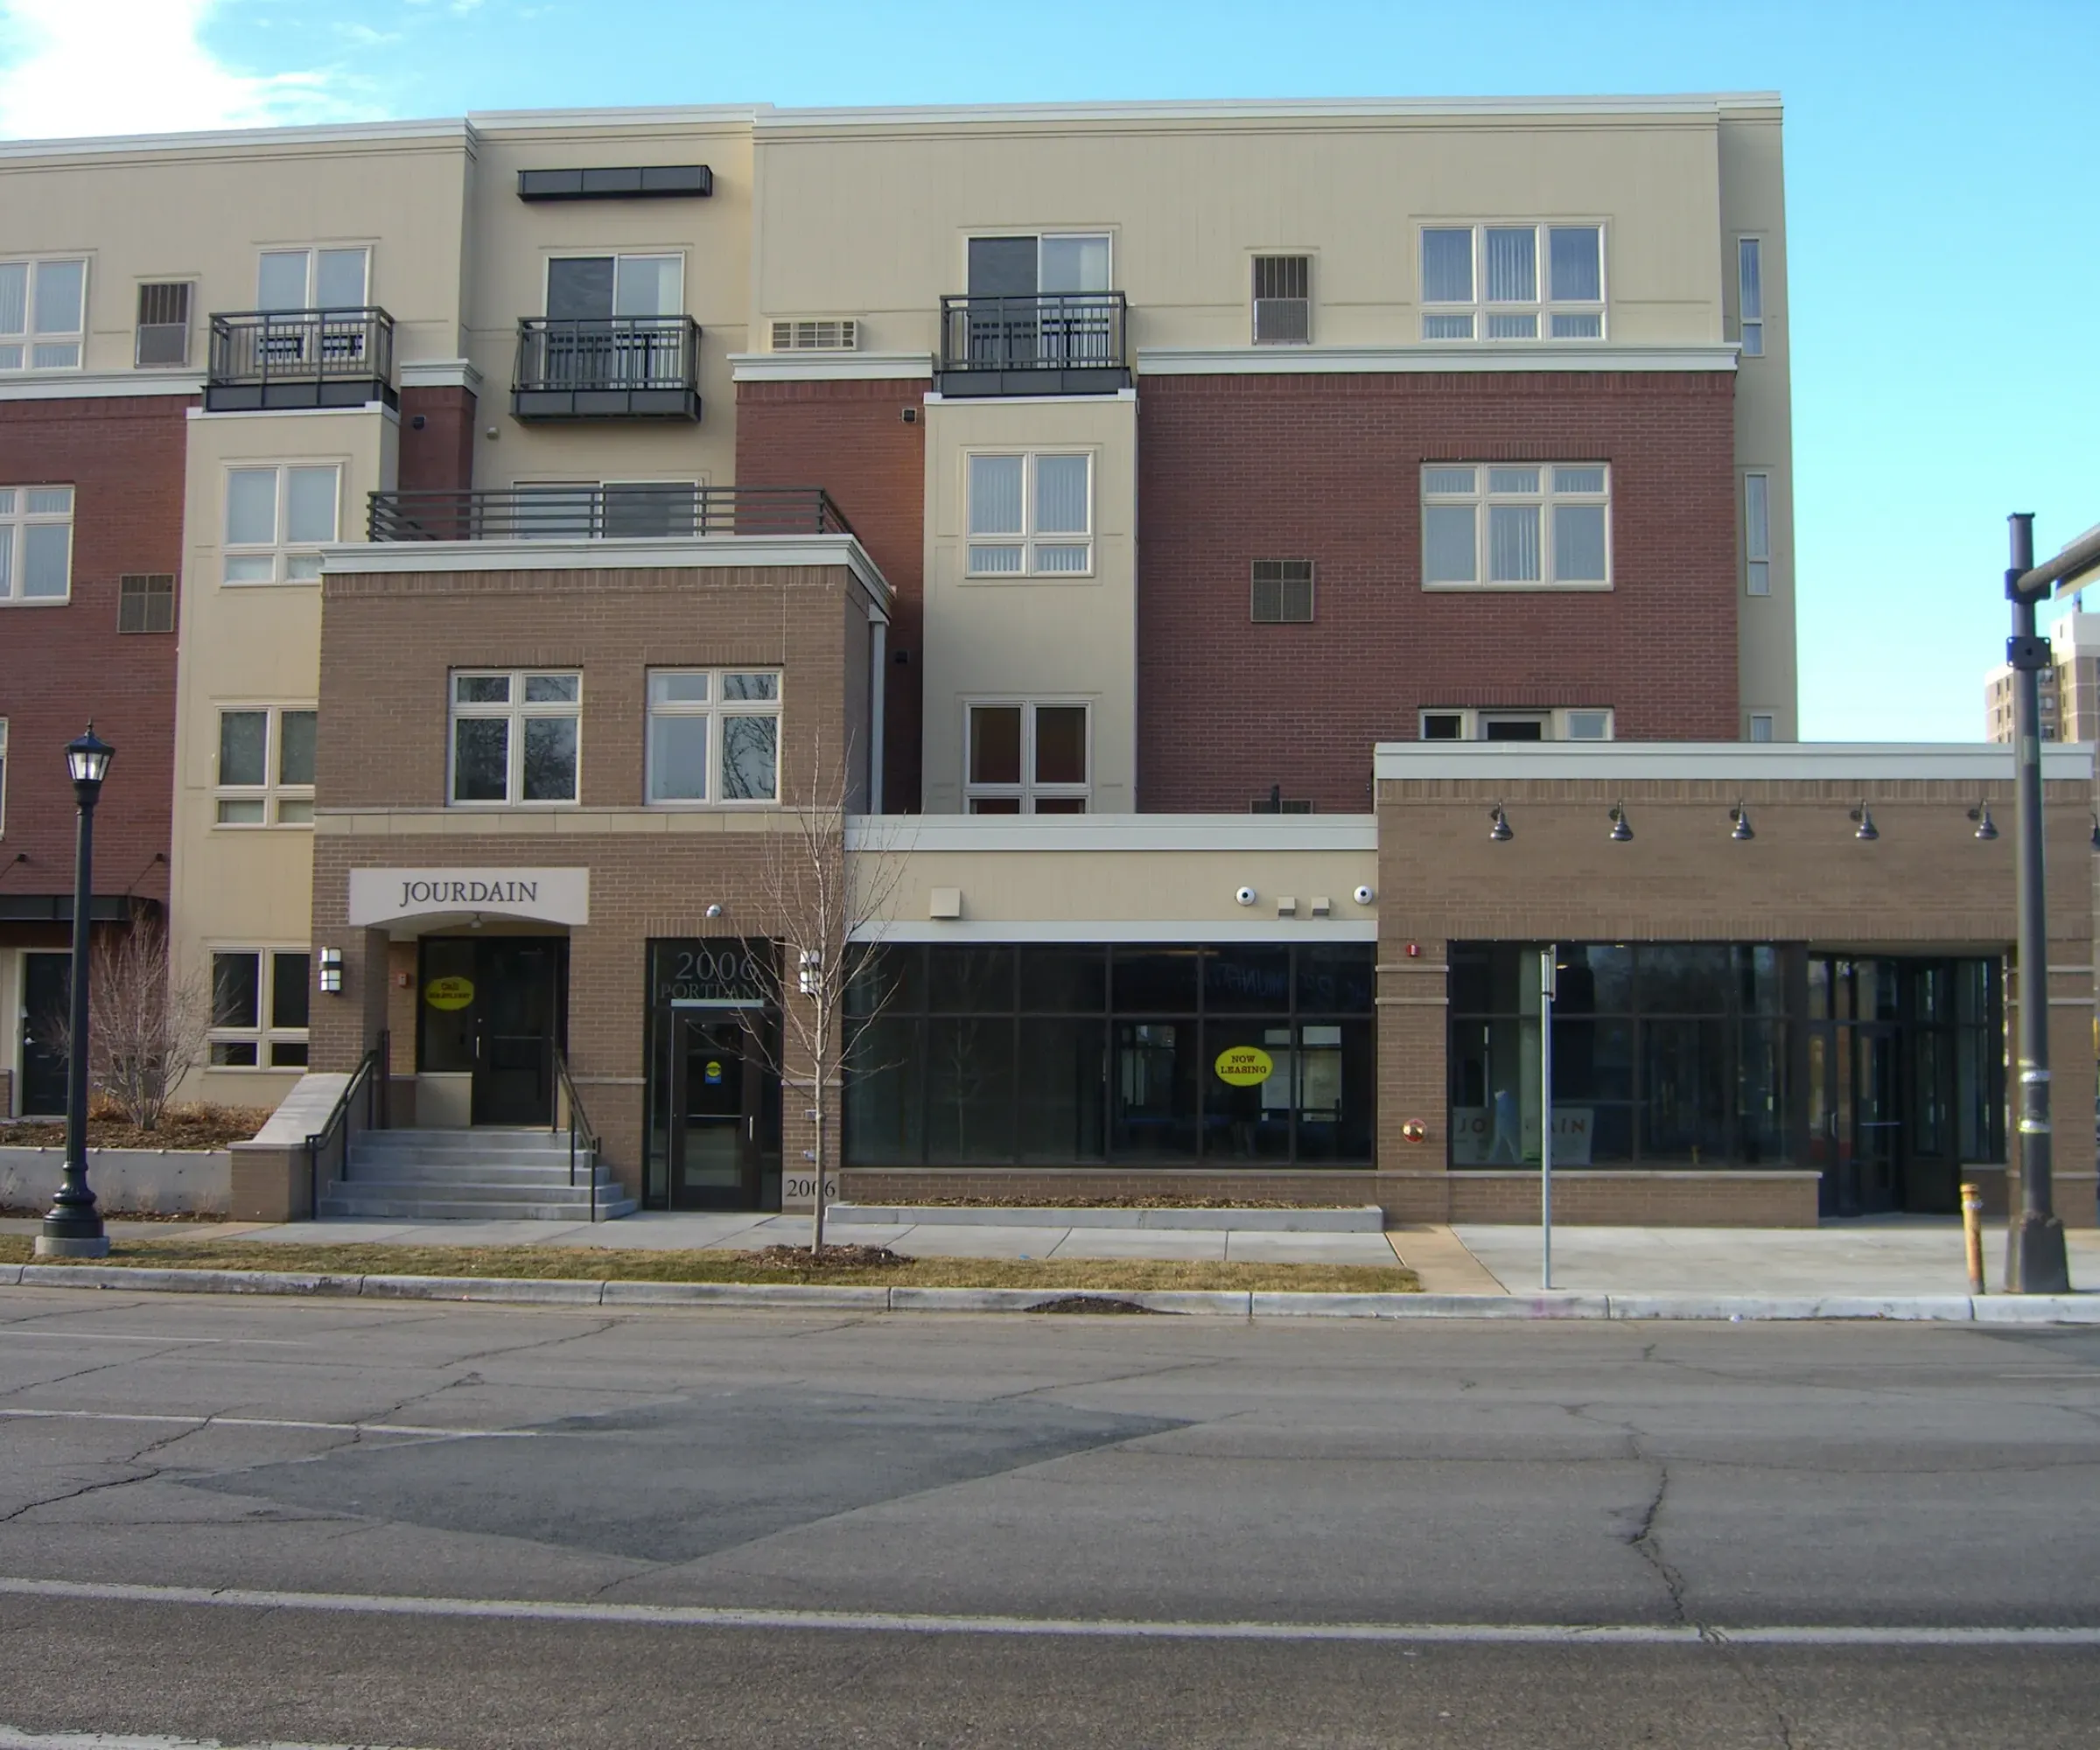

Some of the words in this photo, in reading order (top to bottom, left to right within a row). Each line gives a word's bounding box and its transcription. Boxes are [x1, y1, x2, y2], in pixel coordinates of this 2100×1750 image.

[400, 881, 537, 907] JOURDAIN
[676, 952, 758, 980] 2006
[1221, 1066, 1267, 1074] LEASING
